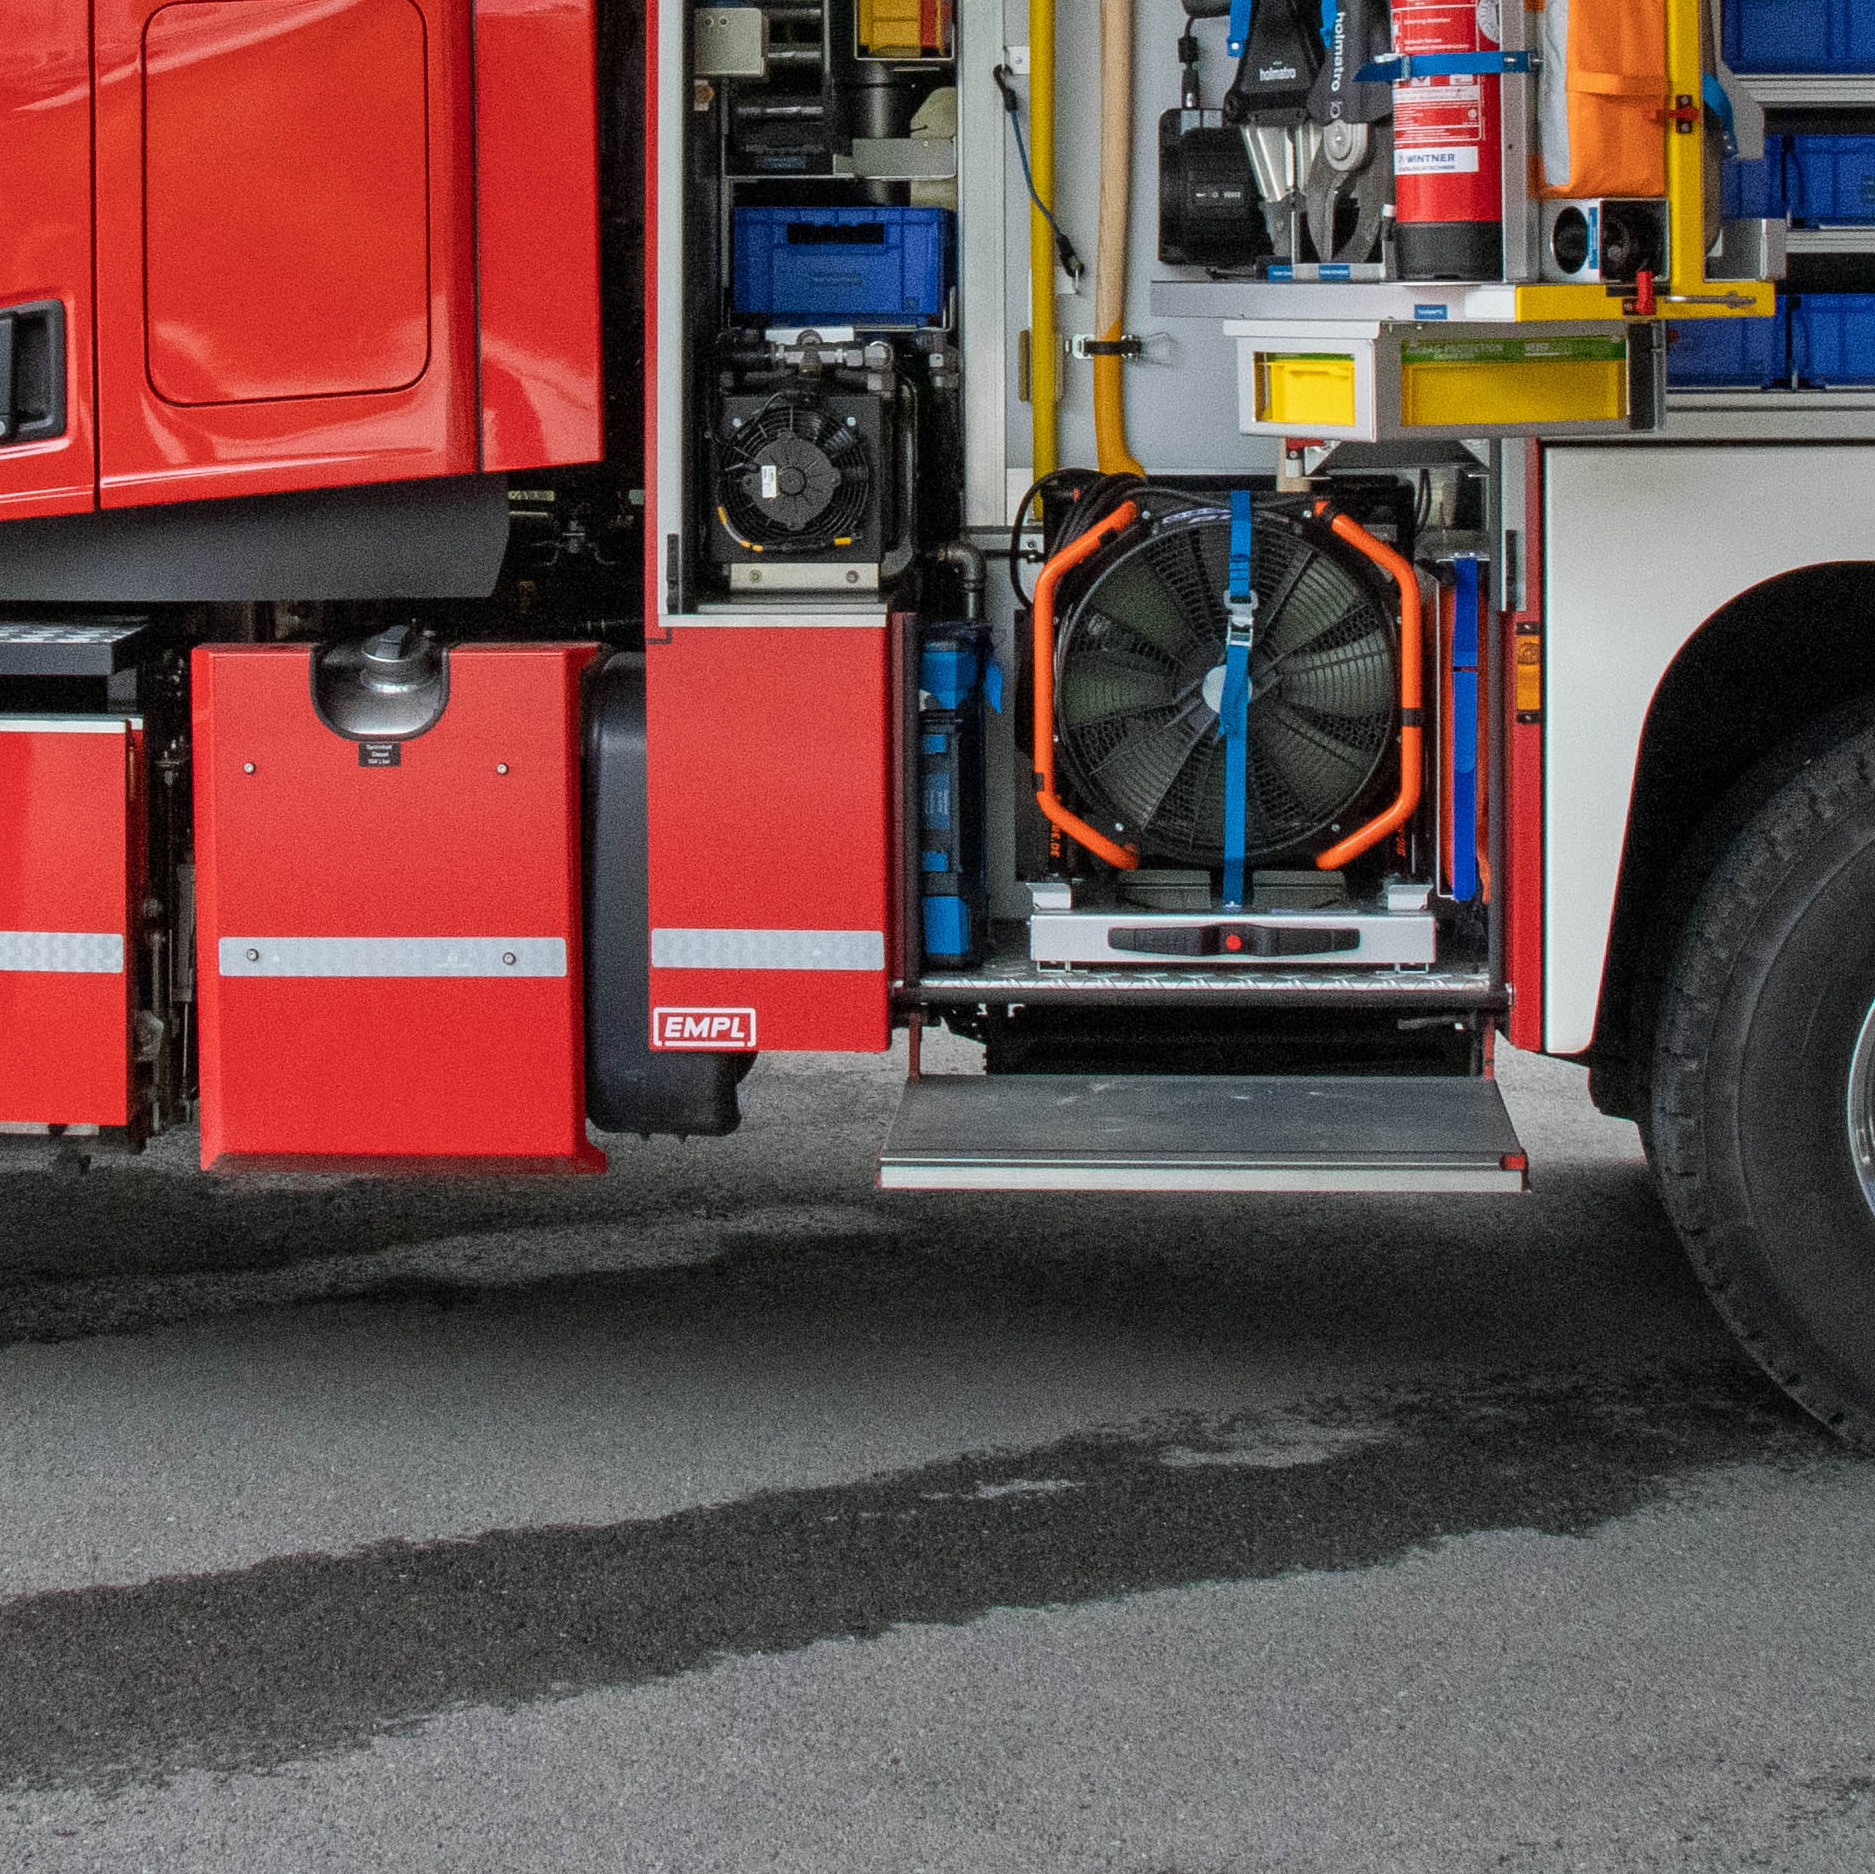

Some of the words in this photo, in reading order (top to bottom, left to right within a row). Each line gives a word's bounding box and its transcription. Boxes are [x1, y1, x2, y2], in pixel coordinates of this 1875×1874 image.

[1330, 11, 1346, 92] holmatro
[1406, 151, 1456, 166] WINTNER
[663, 1016, 746, 1039] EMPL
